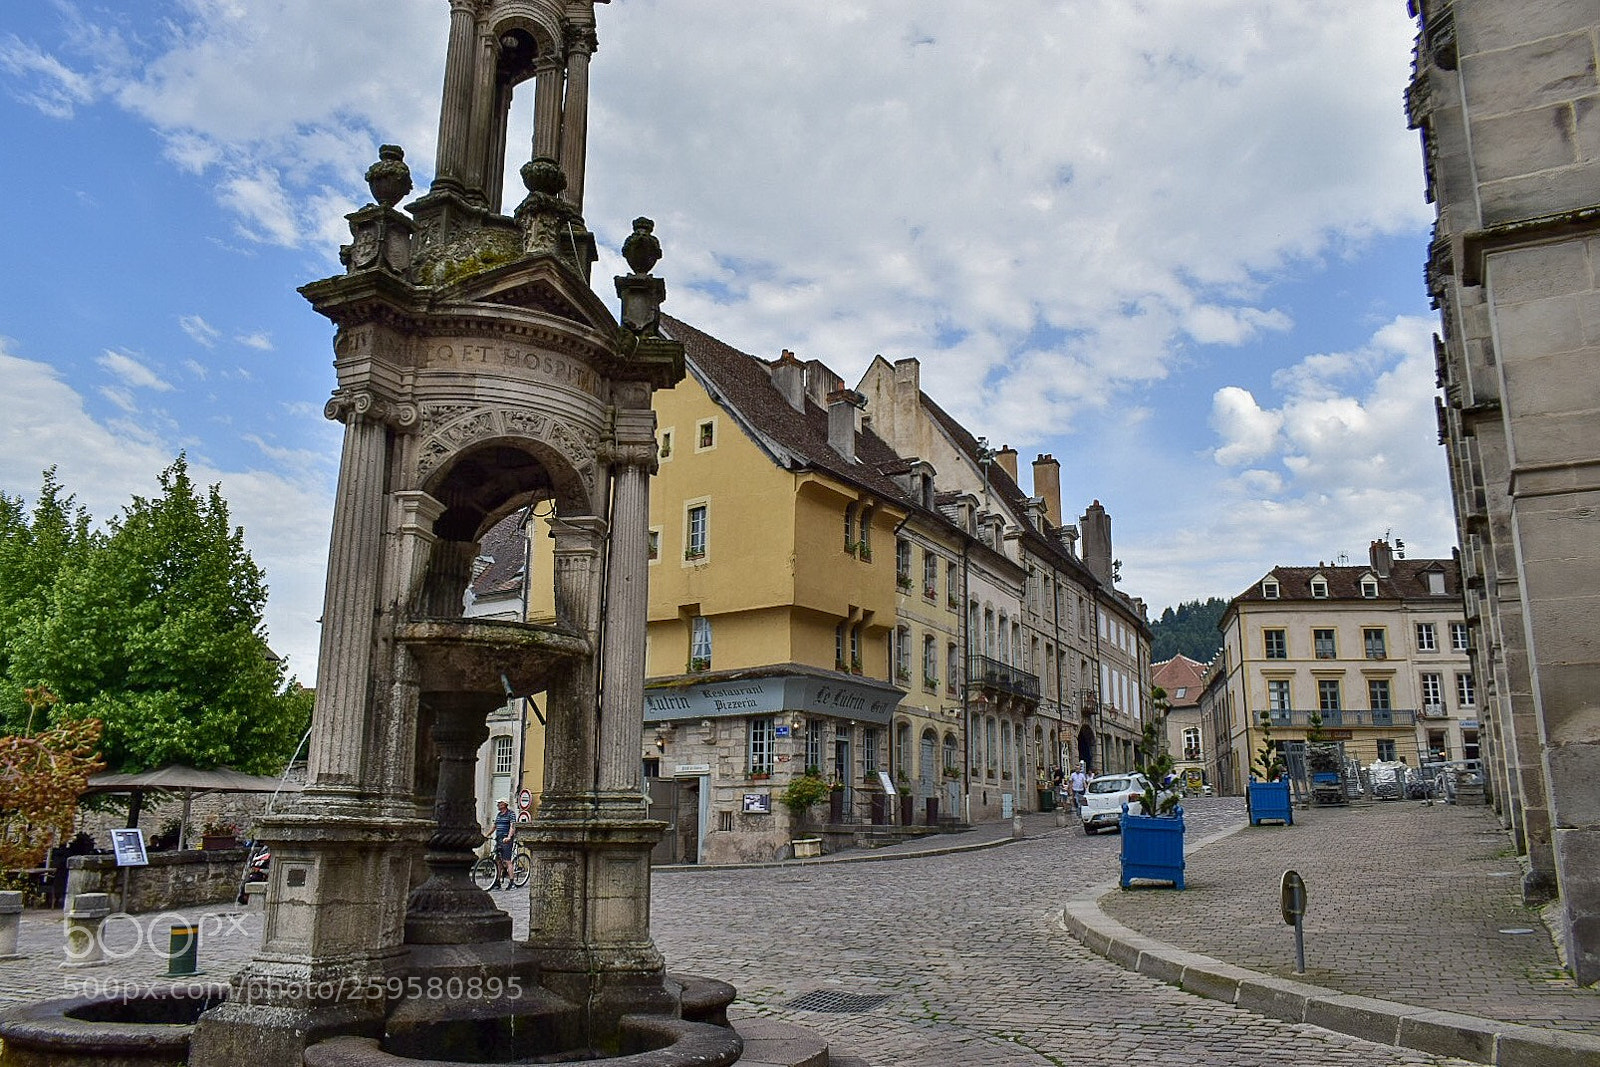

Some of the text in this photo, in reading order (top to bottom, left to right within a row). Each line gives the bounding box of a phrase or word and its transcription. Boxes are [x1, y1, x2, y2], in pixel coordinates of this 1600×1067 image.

[462, 345, 493, 362] ET
[702, 685, 764, 699] Restaurant
[814, 686, 831, 706] Le
[833, 689, 865, 710] Lutrin
[646, 694, 691, 714] Lutrin
[715, 697, 758, 712] Pizzeria
